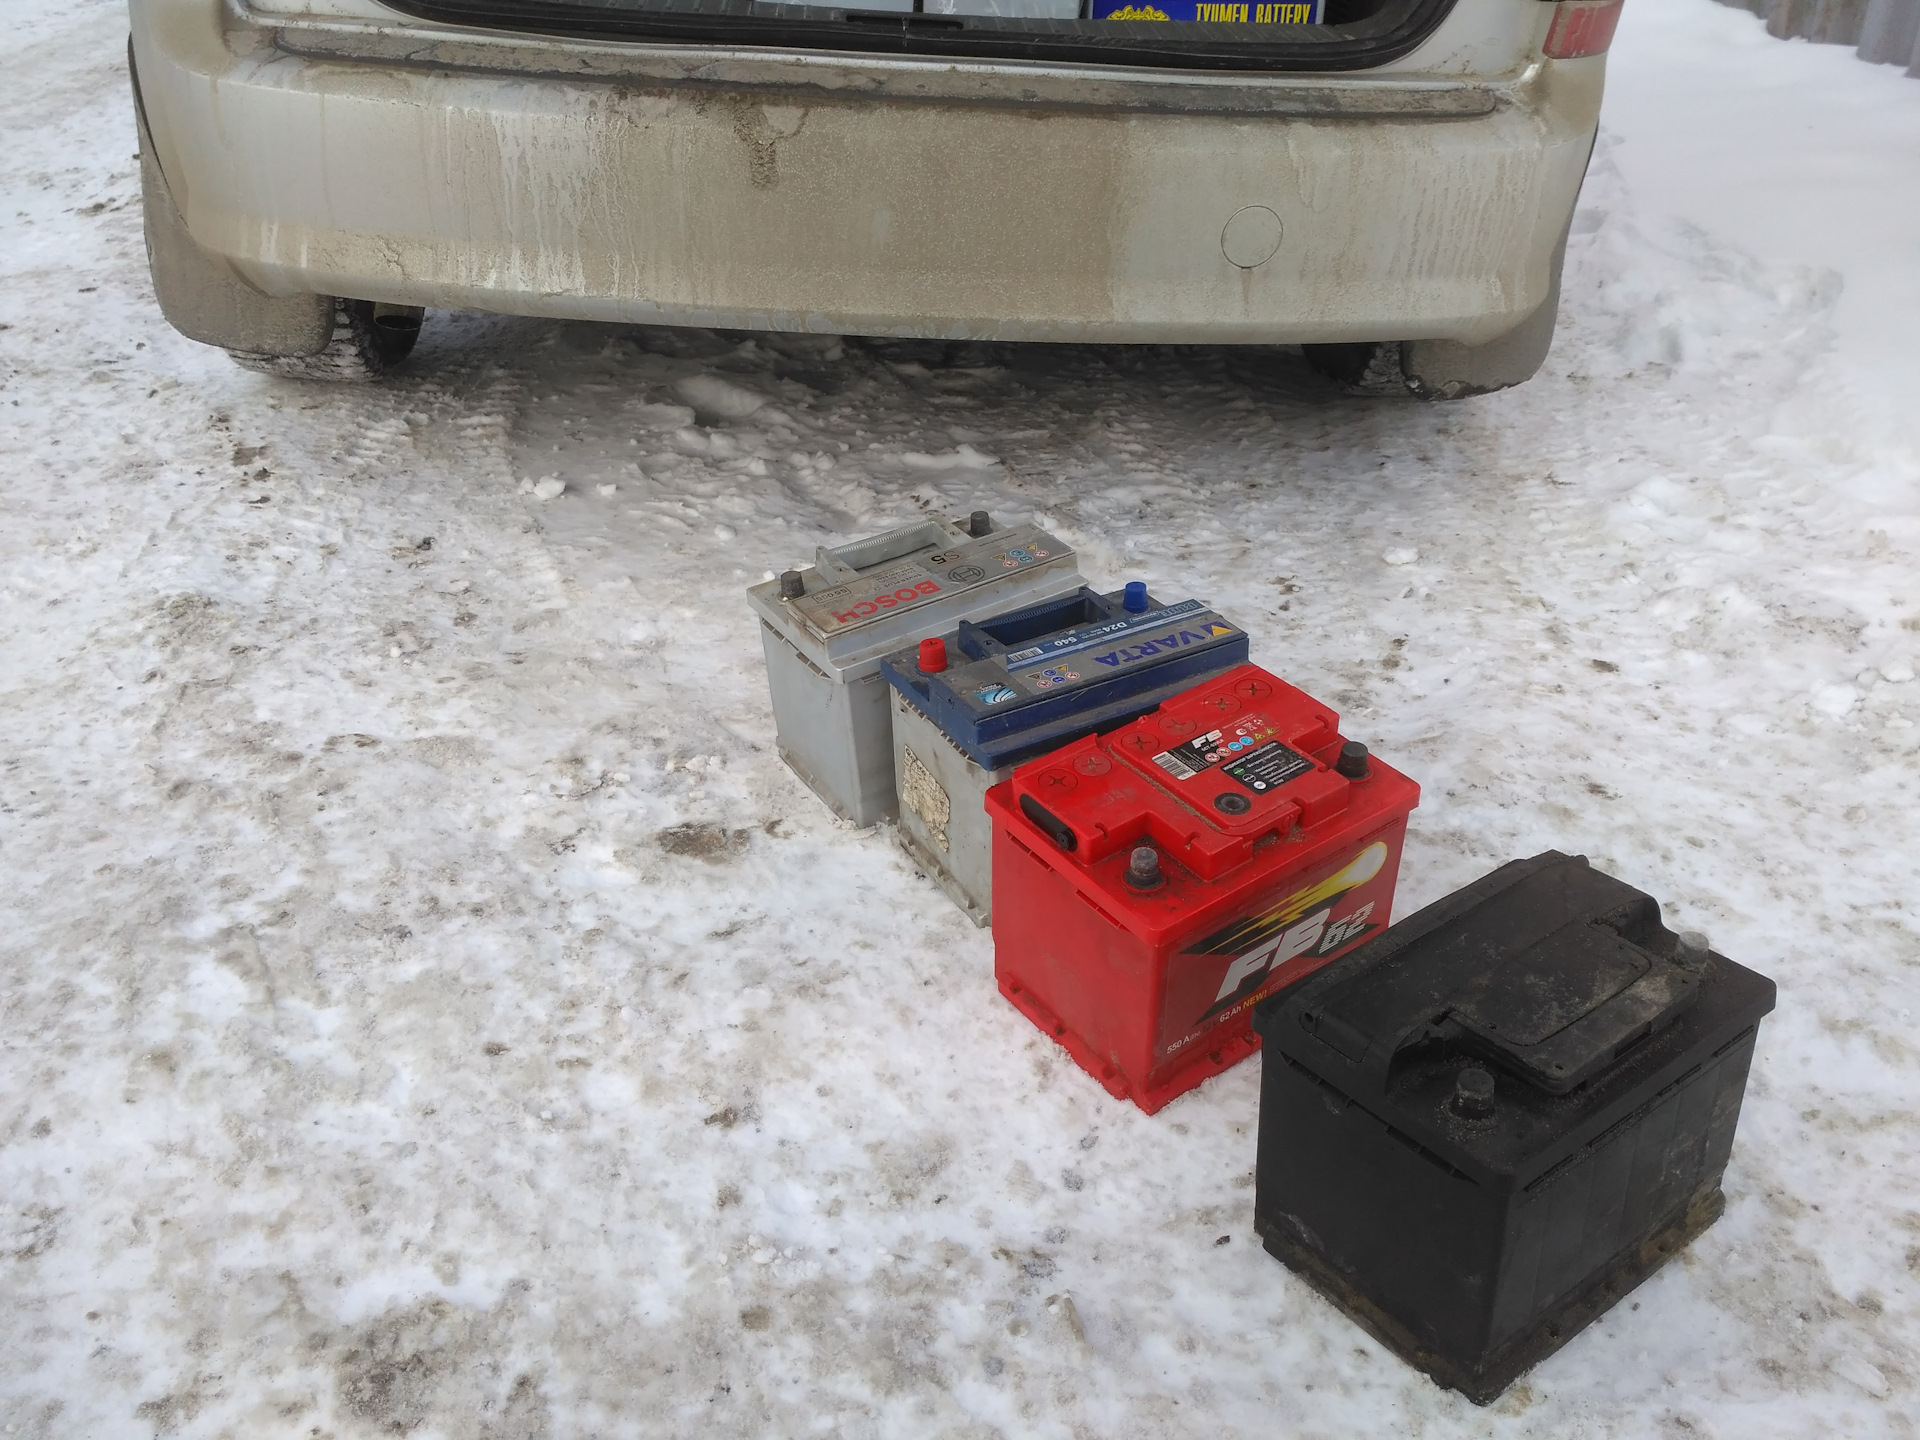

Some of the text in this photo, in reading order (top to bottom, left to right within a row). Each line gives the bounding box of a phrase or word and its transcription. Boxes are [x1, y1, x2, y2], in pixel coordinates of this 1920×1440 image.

[1197, 3, 1310, 24] TYUMEN BATTERY
[931, 551, 960, 564] S5
[831, 580, 941, 624] BOSCH
[1103, 622, 1127, 632] D24
[1054, 637, 1077, 647] 540
[1095, 631, 1205, 667] VARTA
[1191, 729, 1222, 749] FB
[1215, 901, 1375, 1003] FB 62
[1167, 1040, 1182, 1054] 550
[1242, 989, 1268, 1010] NEW!
